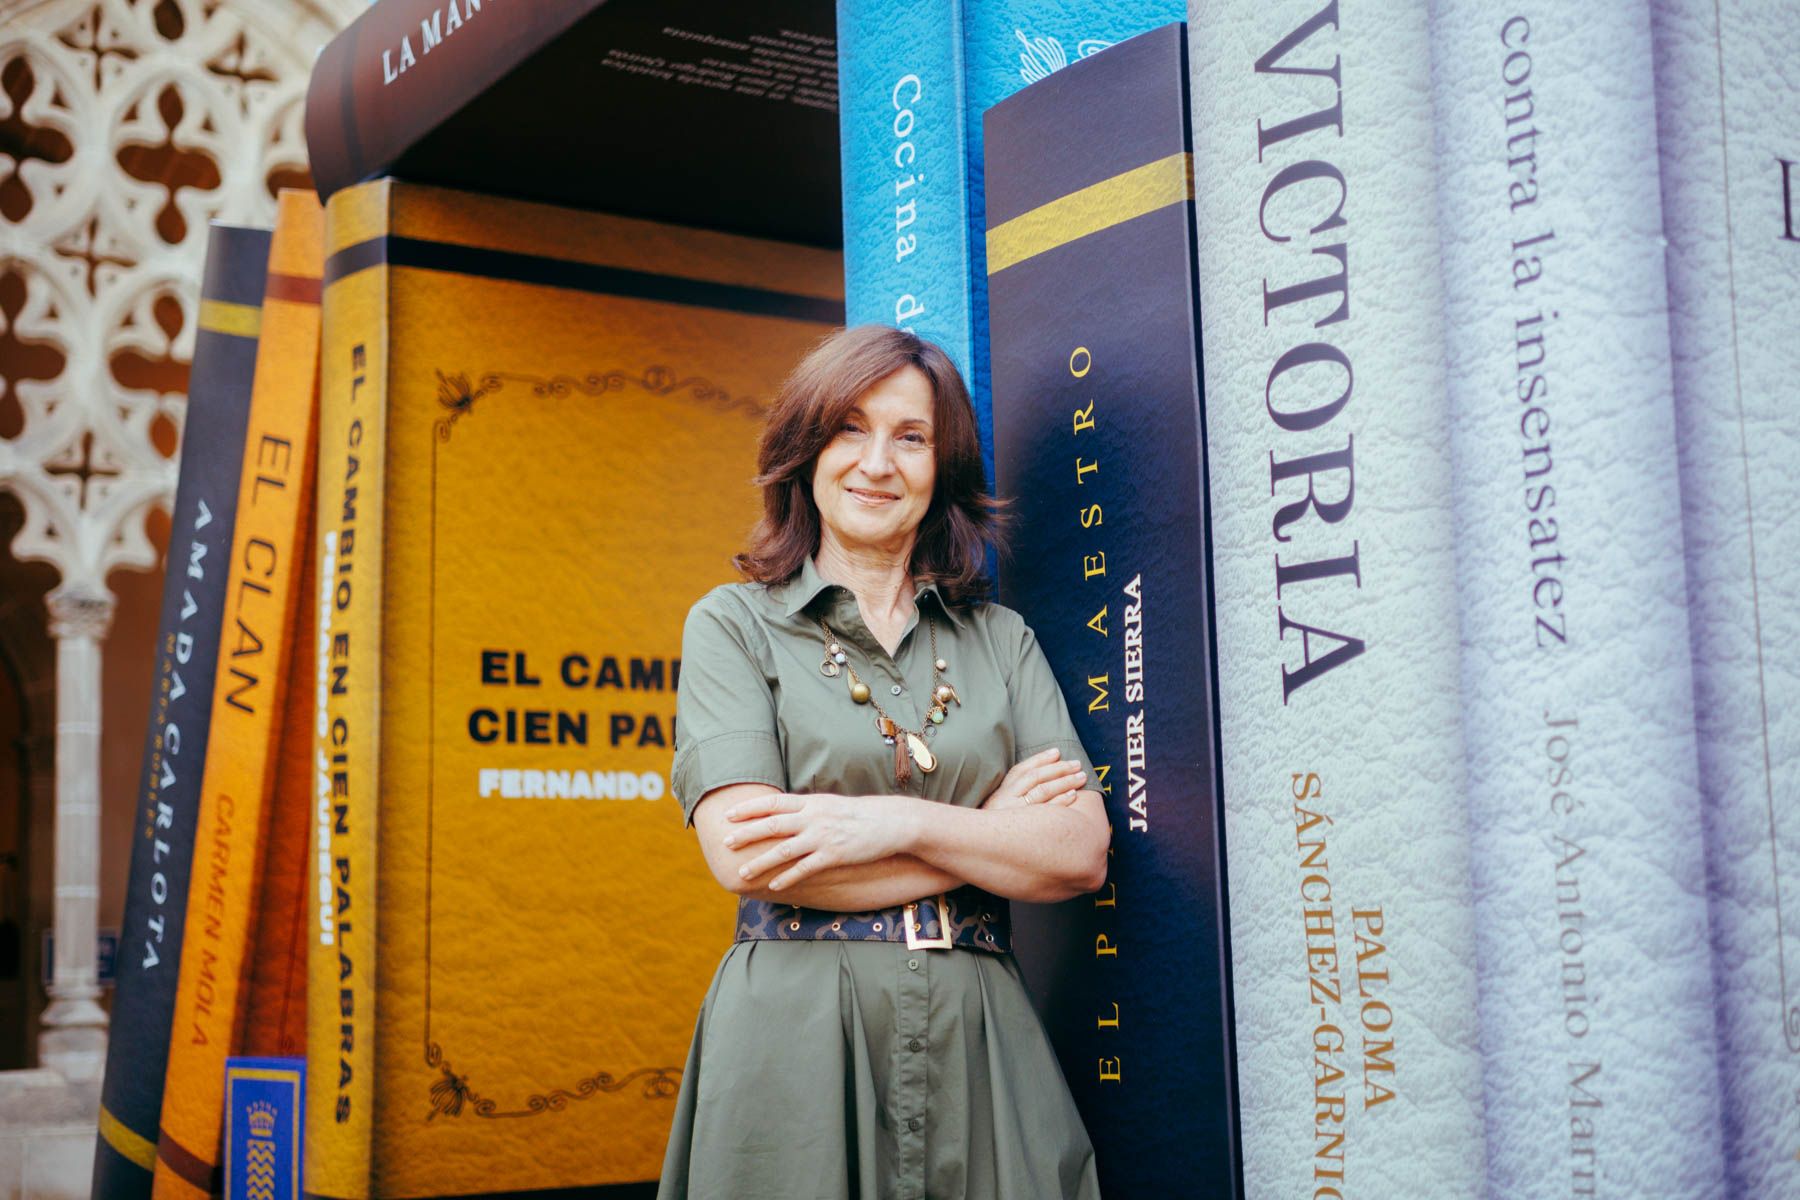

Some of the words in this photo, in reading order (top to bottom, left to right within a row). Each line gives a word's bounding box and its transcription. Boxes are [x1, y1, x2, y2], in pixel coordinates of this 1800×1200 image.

[382, 34, 417, 86] LA
[420, 0, 488, 55] MAN
[892, 74, 924, 263] Cocina
[1500, 15, 1543, 214] contra
[896, 294, 925, 336] d
[1512, 229, 1556, 292] la
[349, 343, 368, 404] EL
[1254, 0, 1366, 706] VICTORIA
[251, 433, 292, 507] EL
[335, 419, 363, 612] CAMBIO
[1069, 346, 1109, 715] MAESTRO
[1514, 309, 1569, 649] insensatez
[169, 498, 213, 702] AMADA
[224, 536, 277, 714] CLAN
[331, 631, 351, 697] EN
[1123, 573, 1143, 703] SIERRA
[468, 708, 588, 745] CIEN
[610, 714, 677, 748] PA
[481, 651, 541, 687] EL
[331, 717, 351, 836] CIEN
[478, 768, 665, 800] FERNANDO
[1125, 709, 1148, 832] JAVIER
[1543, 709, 1586, 817] José
[142, 722, 182, 970] CARLOTA
[204, 793, 235, 942] CARMEN
[1094, 765, 1118, 959] PLN
[191, 947, 220, 1047] MOLA
[334, 857, 357, 1126] PALABRAS
[1552, 834, 1601, 1040] Antonio
[1098, 1001, 1121, 1084] EL
[1351, 905, 1397, 1112] PALOMA
